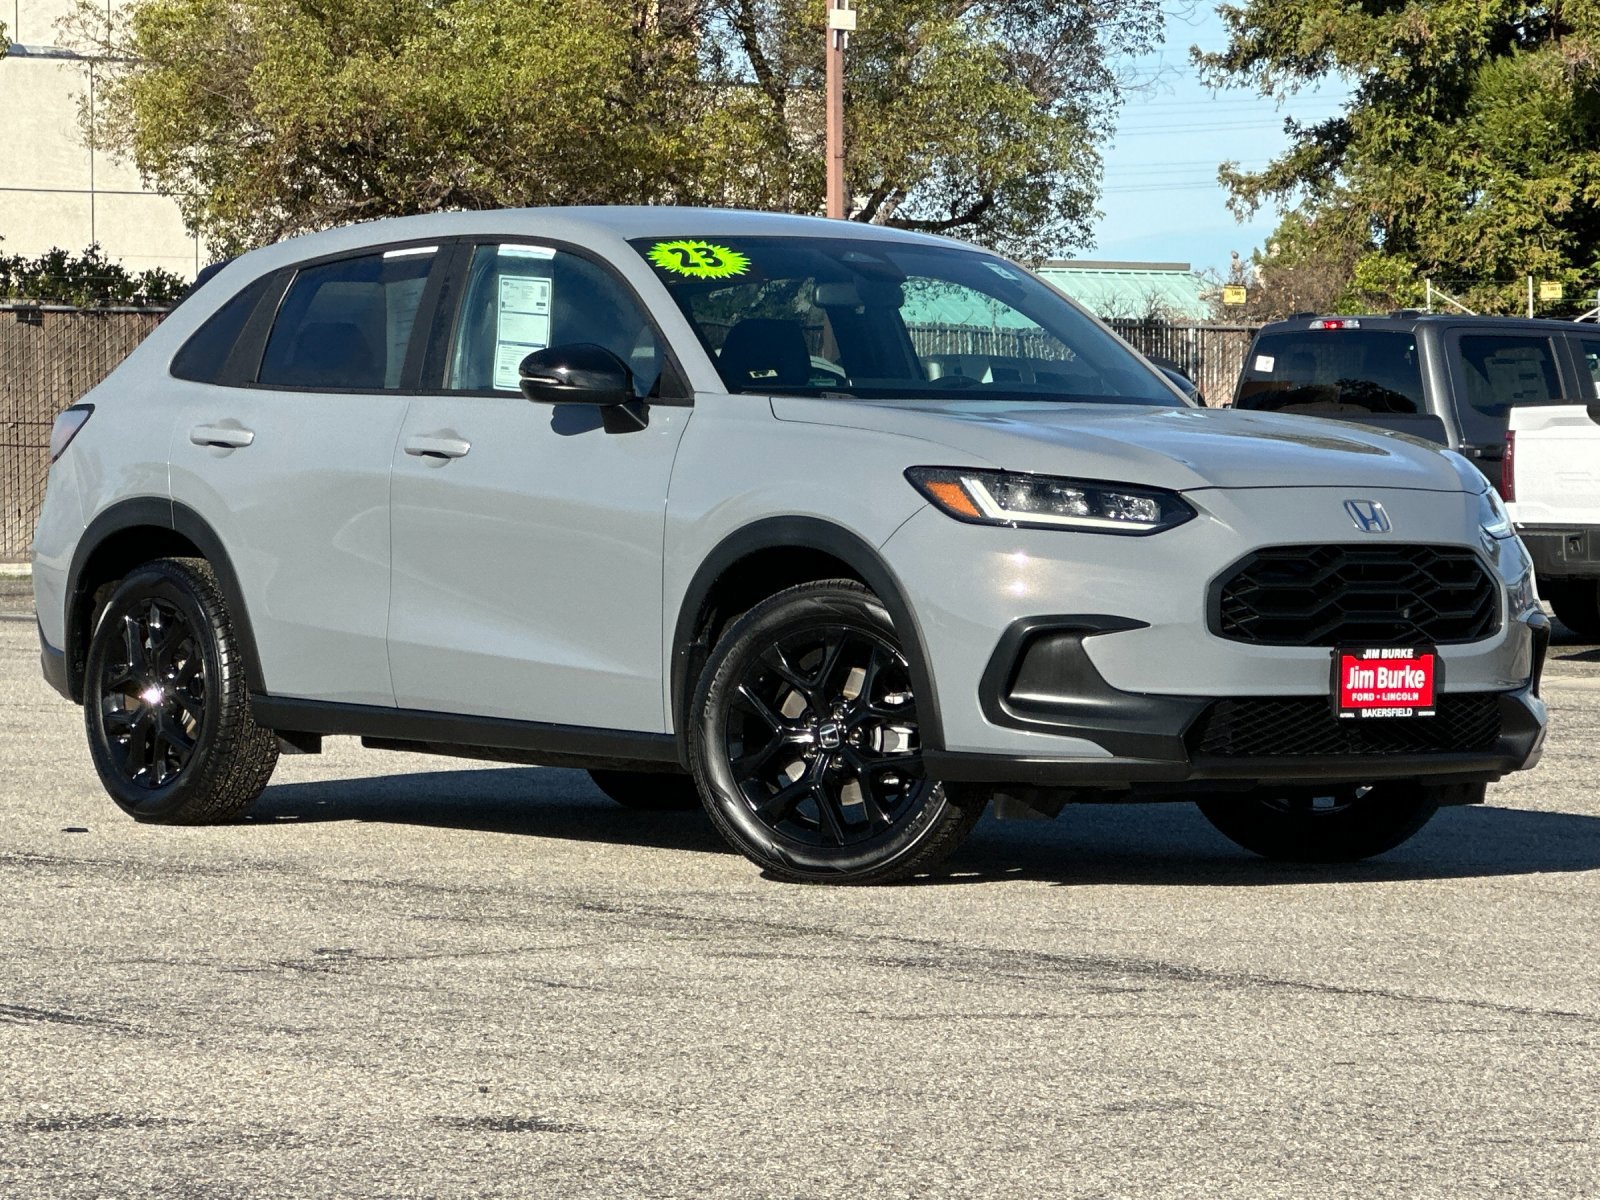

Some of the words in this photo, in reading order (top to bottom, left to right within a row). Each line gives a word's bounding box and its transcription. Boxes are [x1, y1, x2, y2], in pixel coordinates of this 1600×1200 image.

[667, 247, 724, 268] 23
[1363, 649, 1380, 659] JIM
[1381, 648, 1414, 659] BURKE
[1346, 665, 1374, 689] Jim
[1377, 665, 1425, 689] Burke
[1351, 692, 1375, 702] FORD
[1382, 692, 1419, 701] LINCOLN
[1361, 708, 1413, 718] BAKERSFIELD
